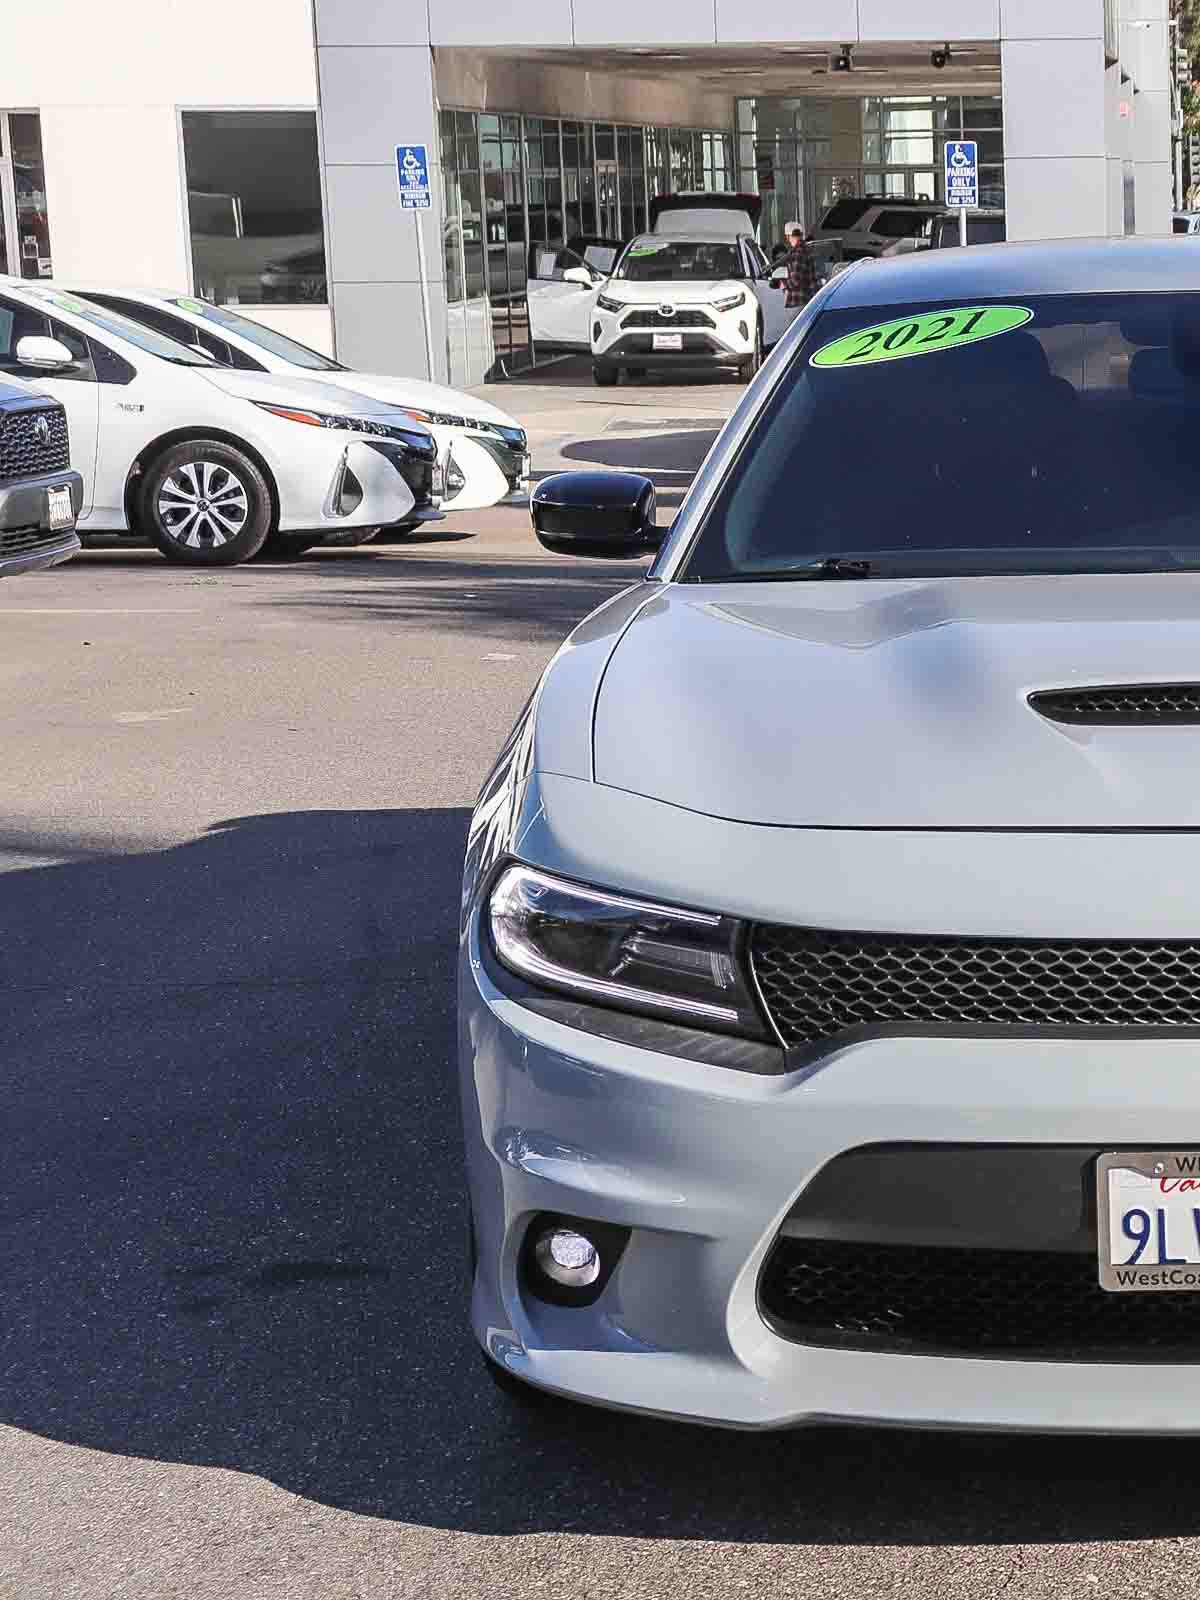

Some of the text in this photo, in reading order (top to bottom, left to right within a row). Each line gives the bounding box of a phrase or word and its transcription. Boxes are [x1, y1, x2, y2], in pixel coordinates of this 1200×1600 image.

[947, 167, 976, 177] PARKING
[952, 176, 971, 187] ONLY
[844, 309, 988, 361] 2021
